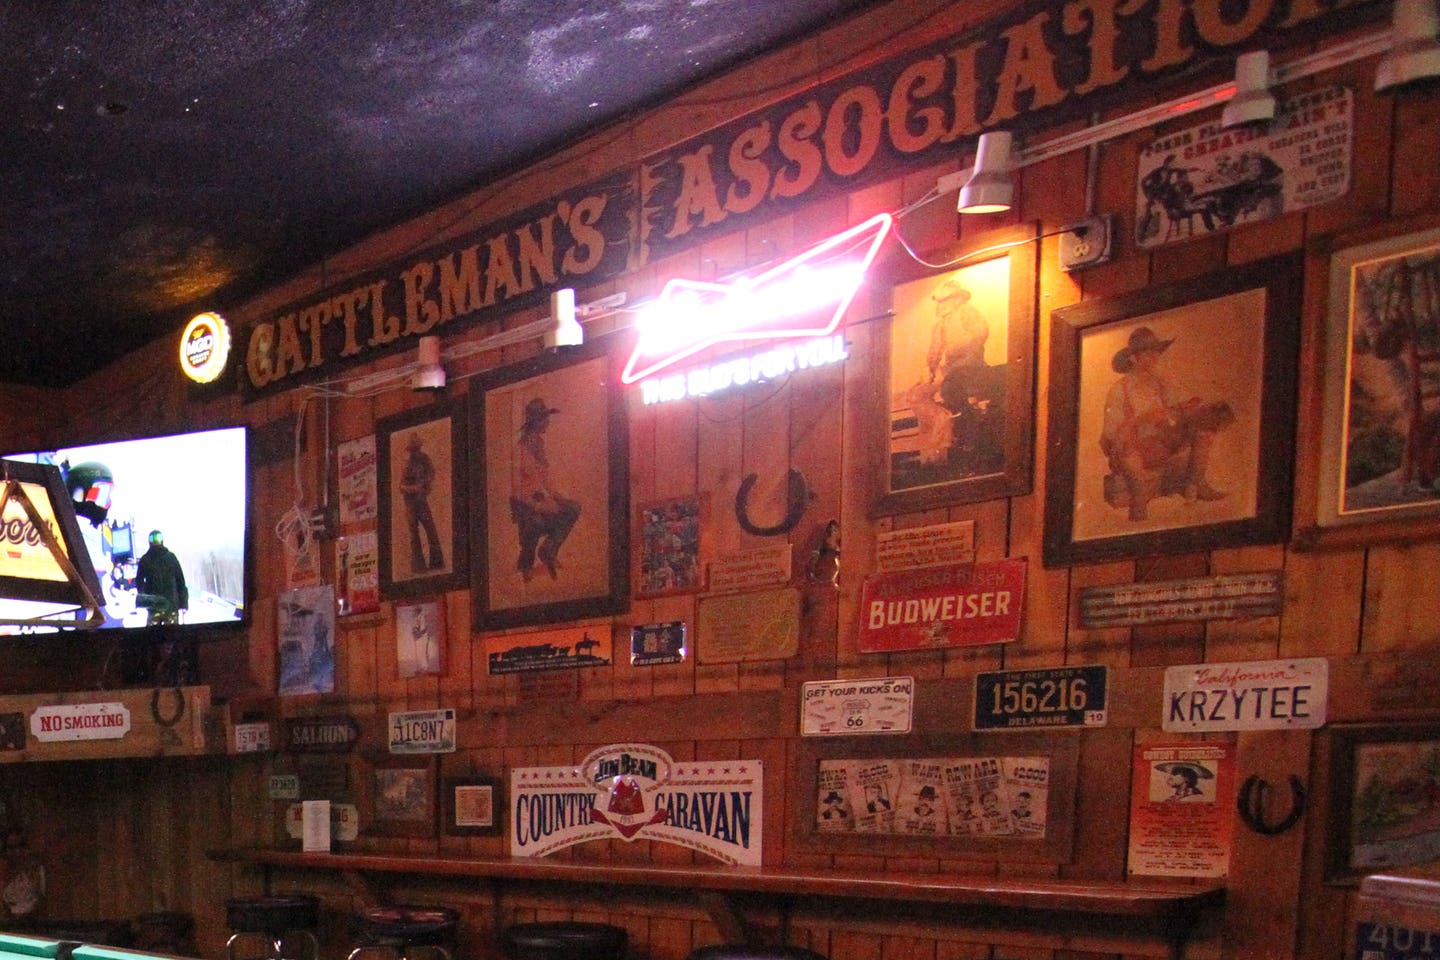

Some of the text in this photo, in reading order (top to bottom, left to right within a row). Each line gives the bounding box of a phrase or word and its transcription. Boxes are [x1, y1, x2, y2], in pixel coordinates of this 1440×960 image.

[246, 192, 608, 387] CATTLEMAN'S
[670, 0, 1350, 238] ASSOCIATIO
[868, 591, 1011, 640] BUDWEISER
[807, 689, 826, 698] GET
[829, 688, 857, 698] YOUR
[860, 685, 890, 695] KICKS
[1196, 668, 1296, 687] California
[992, 678, 1088, 715] 156216
[1169, 685, 1312, 722] KRZYTEE
[40, 713, 124, 732] NO SMOKING
[847, 716, 863, 727] 66
[1008, 715, 1068, 726] DELAWARE
[594, 753, 657, 783] JIM BEAM
[516, 791, 753, 850] COUNTRY CARAVAN
